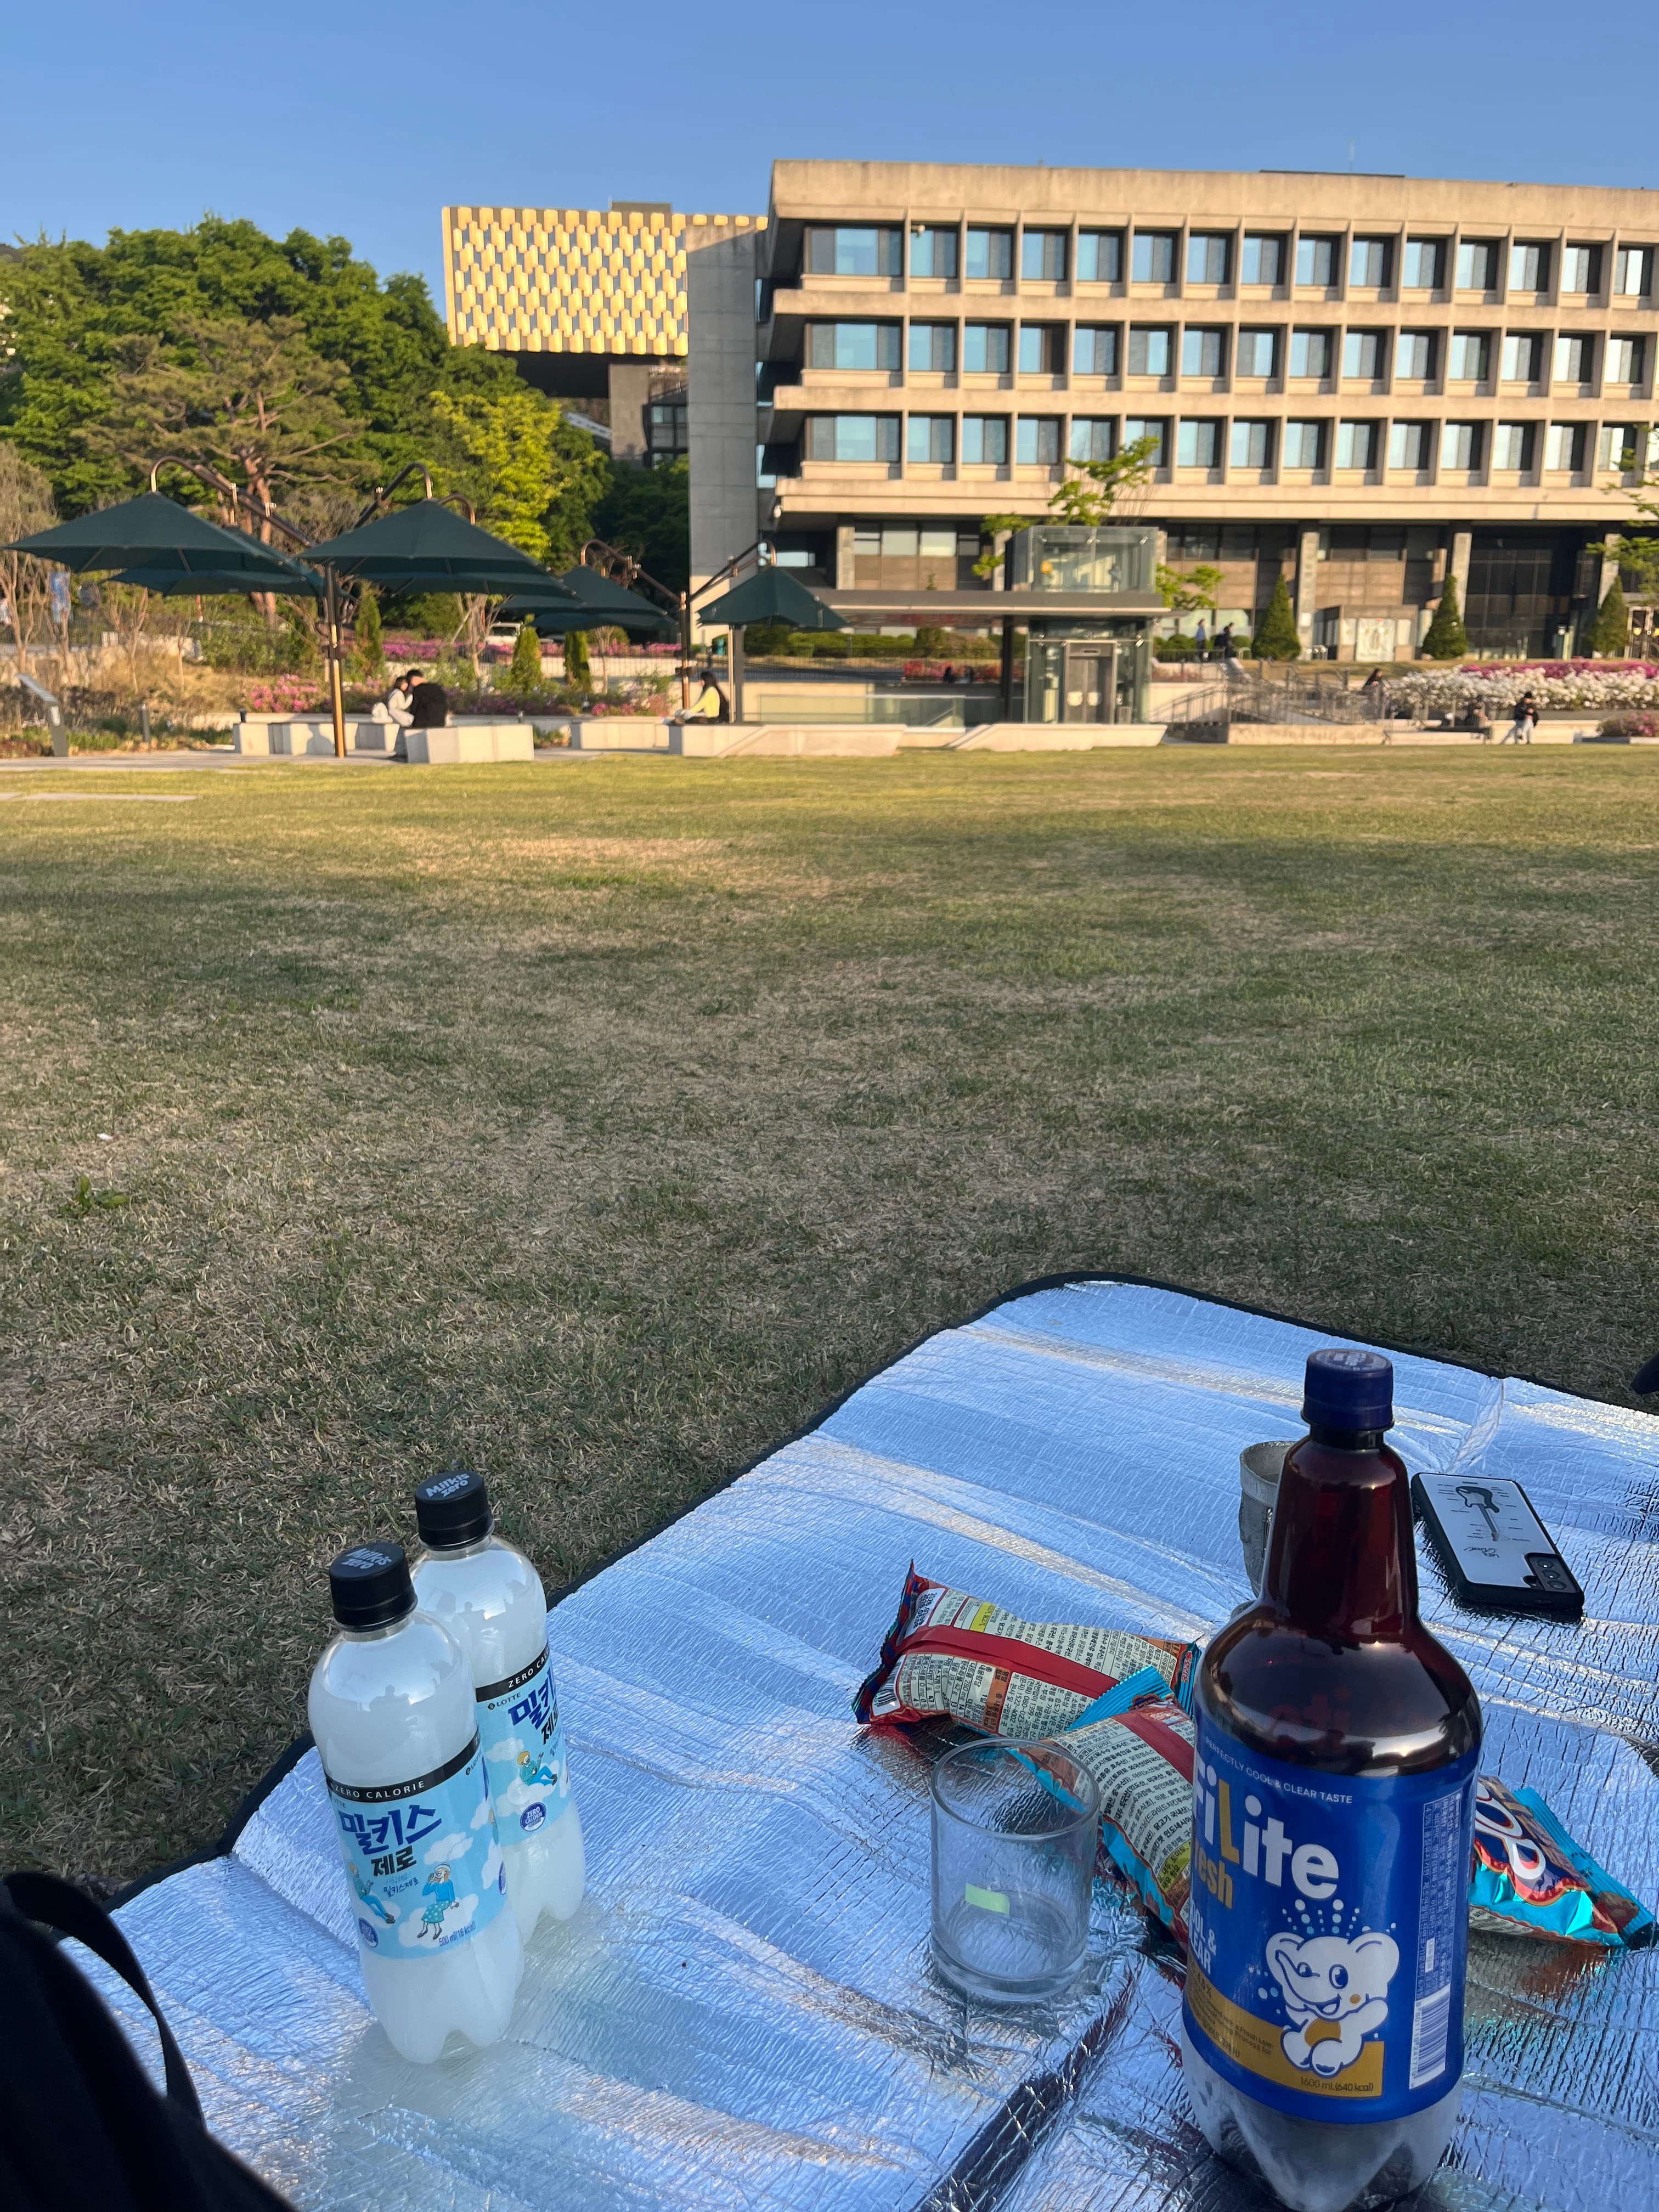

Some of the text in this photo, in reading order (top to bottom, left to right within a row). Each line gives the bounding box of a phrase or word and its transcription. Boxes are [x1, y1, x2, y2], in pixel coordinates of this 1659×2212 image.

[426, 1473, 470, 1497] Milkis
[441, 1480, 468, 1497] zero
[508, 1668, 534, 1688] ZERO
[496, 1692, 522, 1707] LOTTE
[508, 1668, 555, 1726] 밀키
[1069, 1698, 1077, 1714] 소비자
[1009, 1692, 1022, 1723] 1522-4002
[1026, 1702, 1036, 1716] 1399
[1206, 1736, 1353, 1804] PERFECTLY COOL & CLEAR TASTE
[335, 1780, 426, 1799] ZERO CALORIE
[525, 1805, 541, 1818] ZERO
[338, 1804, 442, 1855] 밀키스
[1152, 1813, 1172, 1832] 닭고기
[371, 1846, 417, 1877] 제로
[437, 1934, 450, 1946] 500
[1301, 2076, 1320, 2088] 1600
